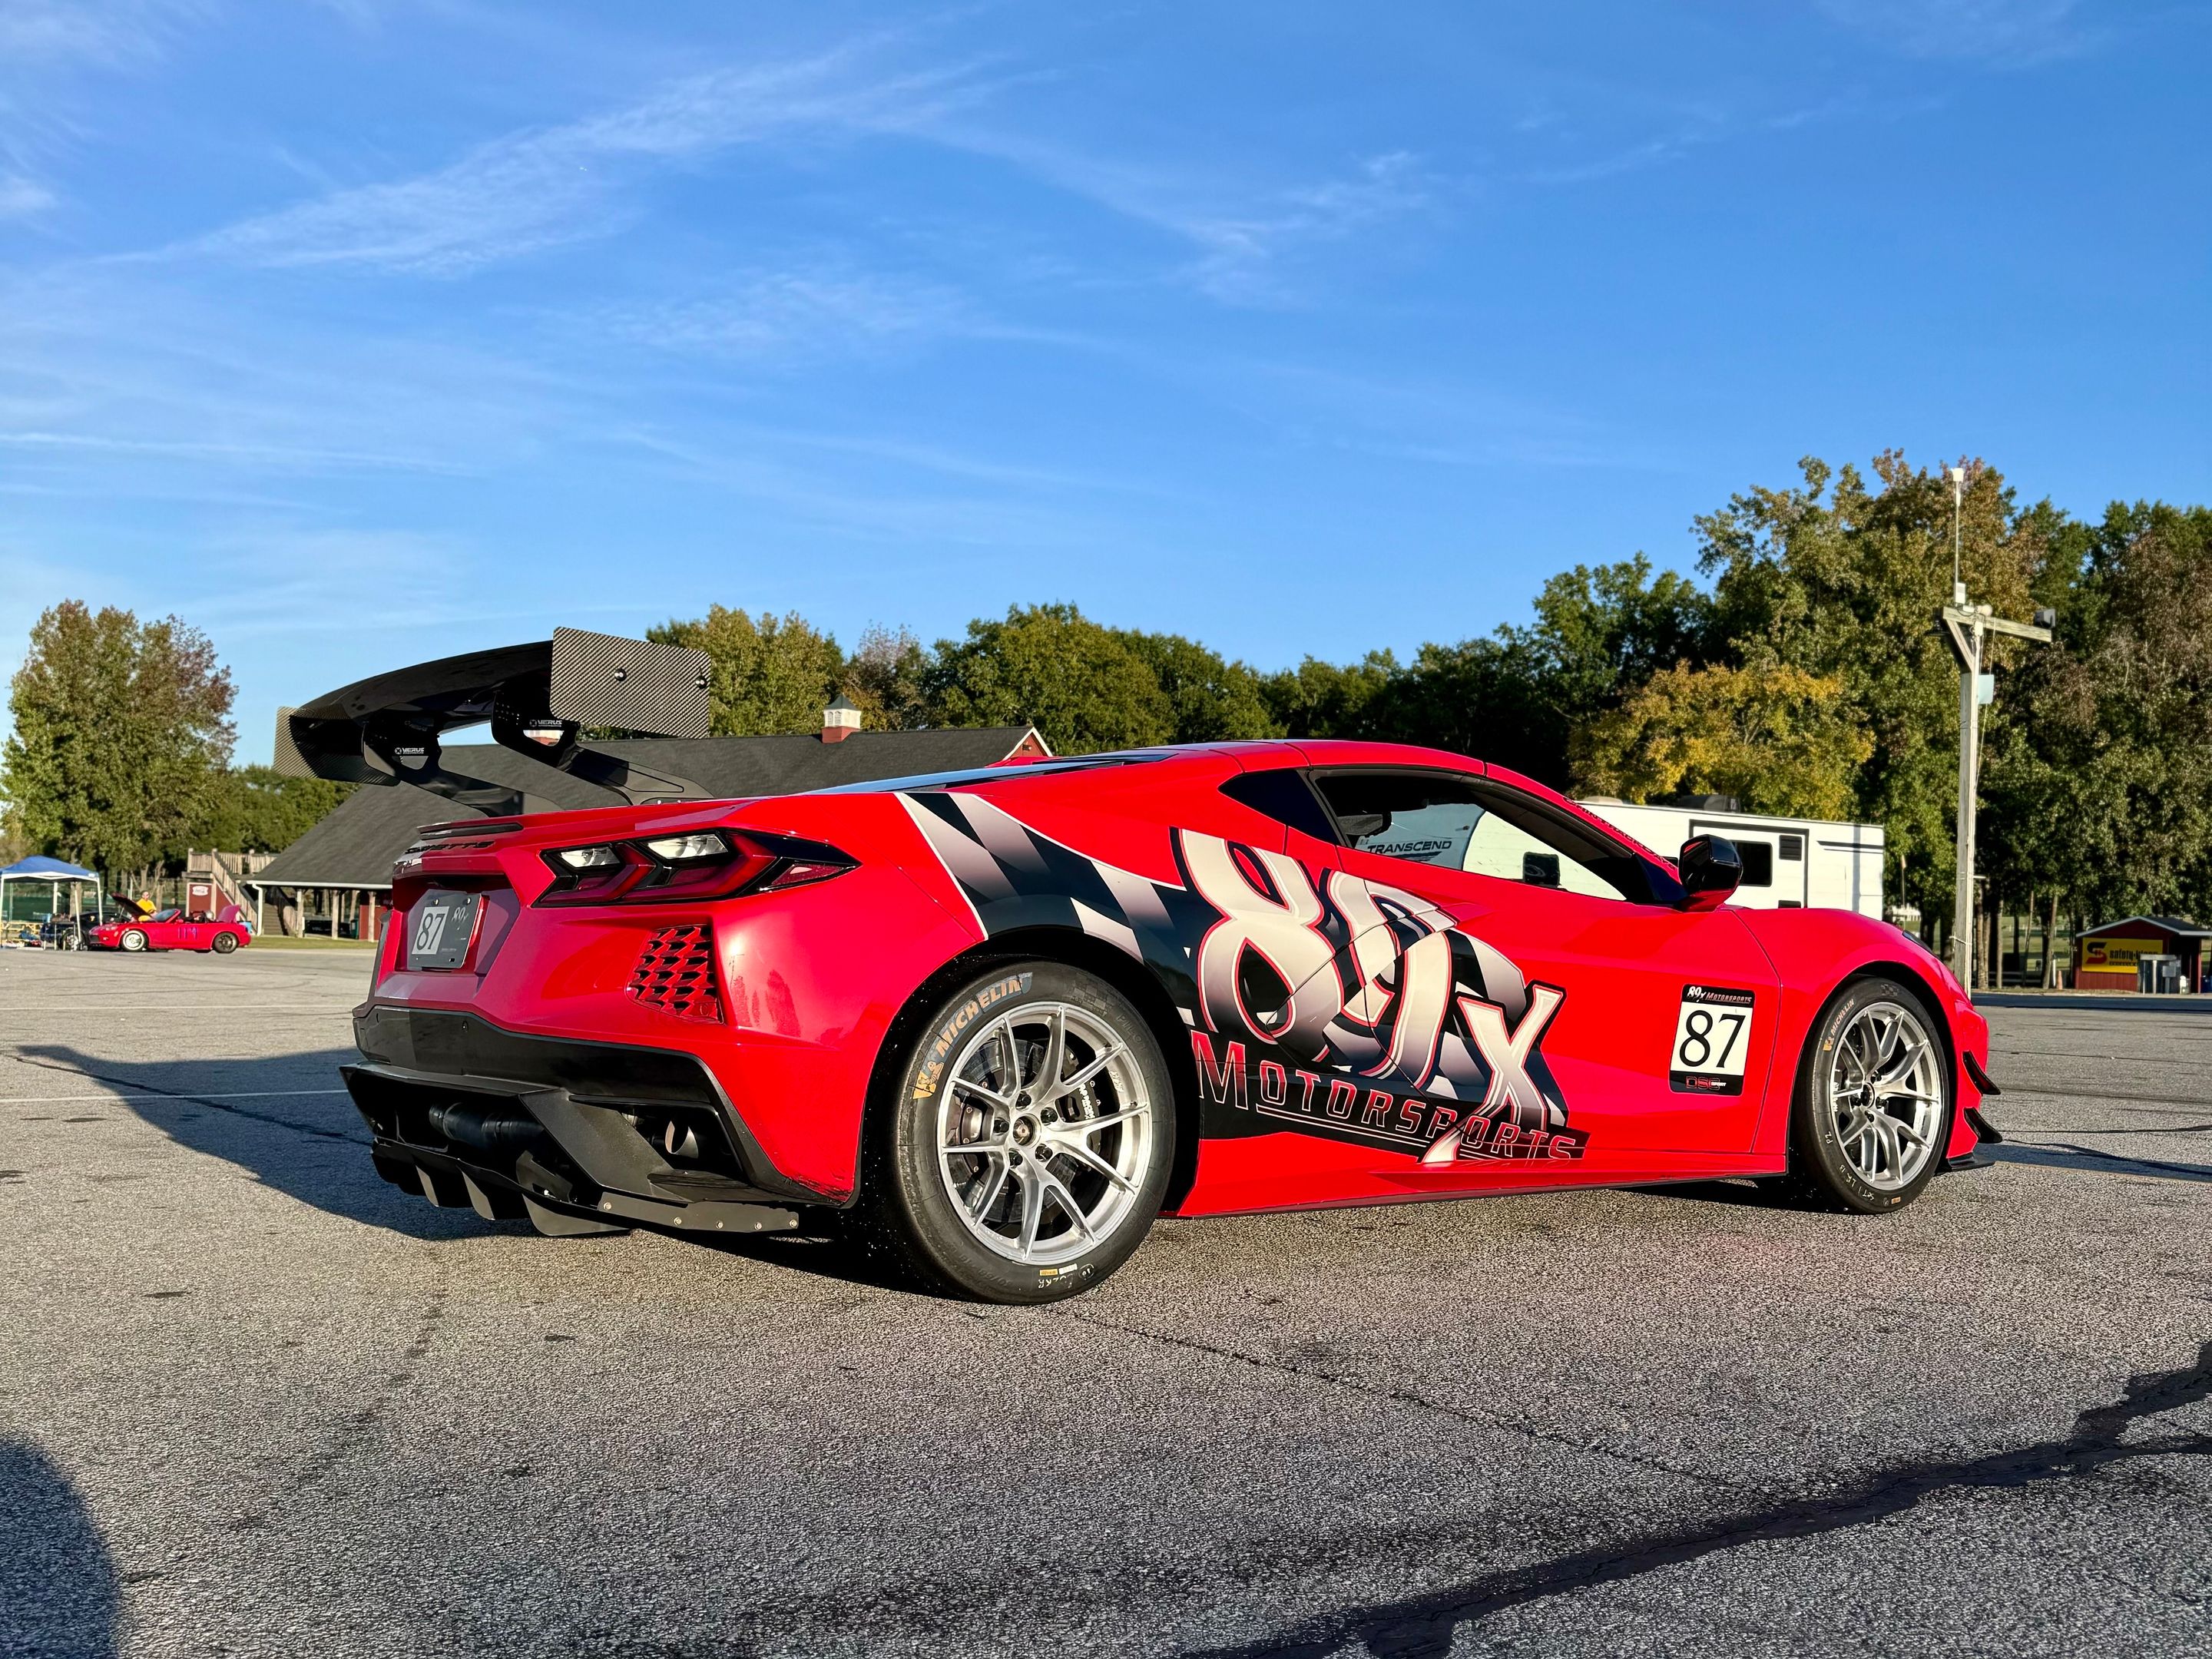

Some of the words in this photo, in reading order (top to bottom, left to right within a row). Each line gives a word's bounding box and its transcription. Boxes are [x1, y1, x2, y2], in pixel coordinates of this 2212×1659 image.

[1367, 841, 1452, 854] TRANSCEND
[416, 912, 446, 951] 87
[1705, 992, 1753, 1004] MOTORSPORTS
[1831, 998, 1855, 1035] MICHELIN
[935, 978, 1023, 1058] MICHELIN
[1679, 1010, 1747, 1068] 87
[1190, 1030, 1576, 1160] MOTORSPORTS
